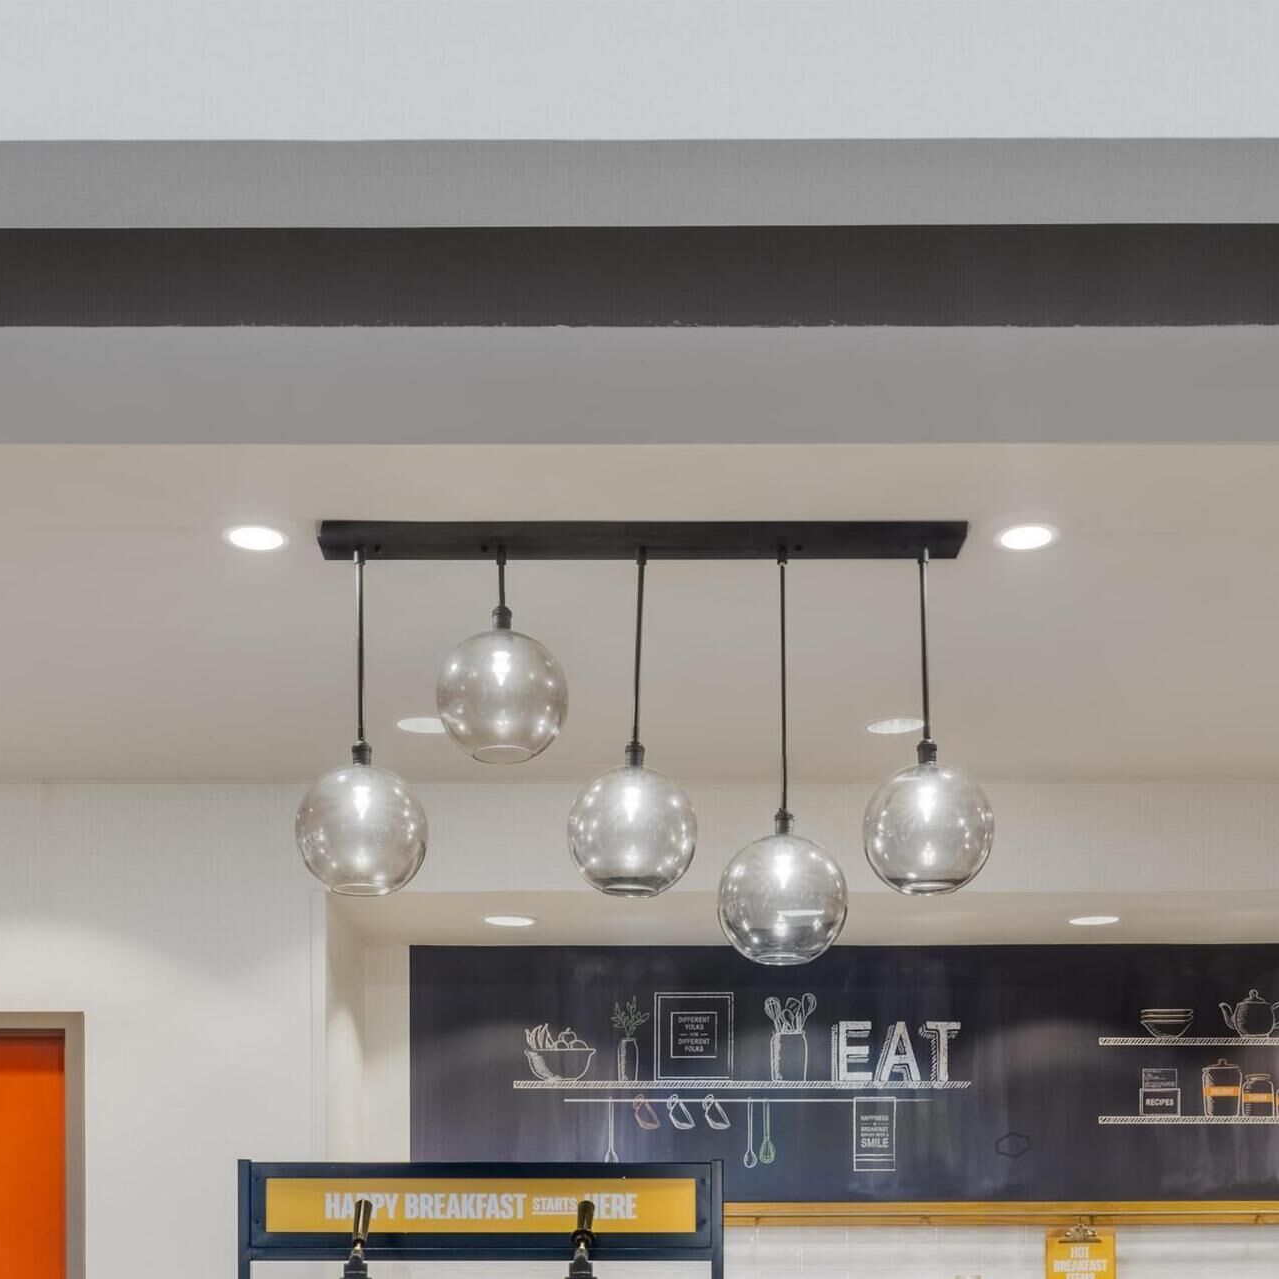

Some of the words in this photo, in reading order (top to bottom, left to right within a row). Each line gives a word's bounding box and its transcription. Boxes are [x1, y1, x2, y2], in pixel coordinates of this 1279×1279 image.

[831, 1020, 961, 1083] EAT
[1145, 1098, 1175, 1106] RECIPES
[860, 1137, 890, 1148] SMILE
[404, 1192, 527, 1220] BREAKFAST
[532, 1196, 578, 1212] STARTS
[1070, 1246, 1089, 1259] HOT
[1053, 1259, 1108, 1272] BREAKFAST
